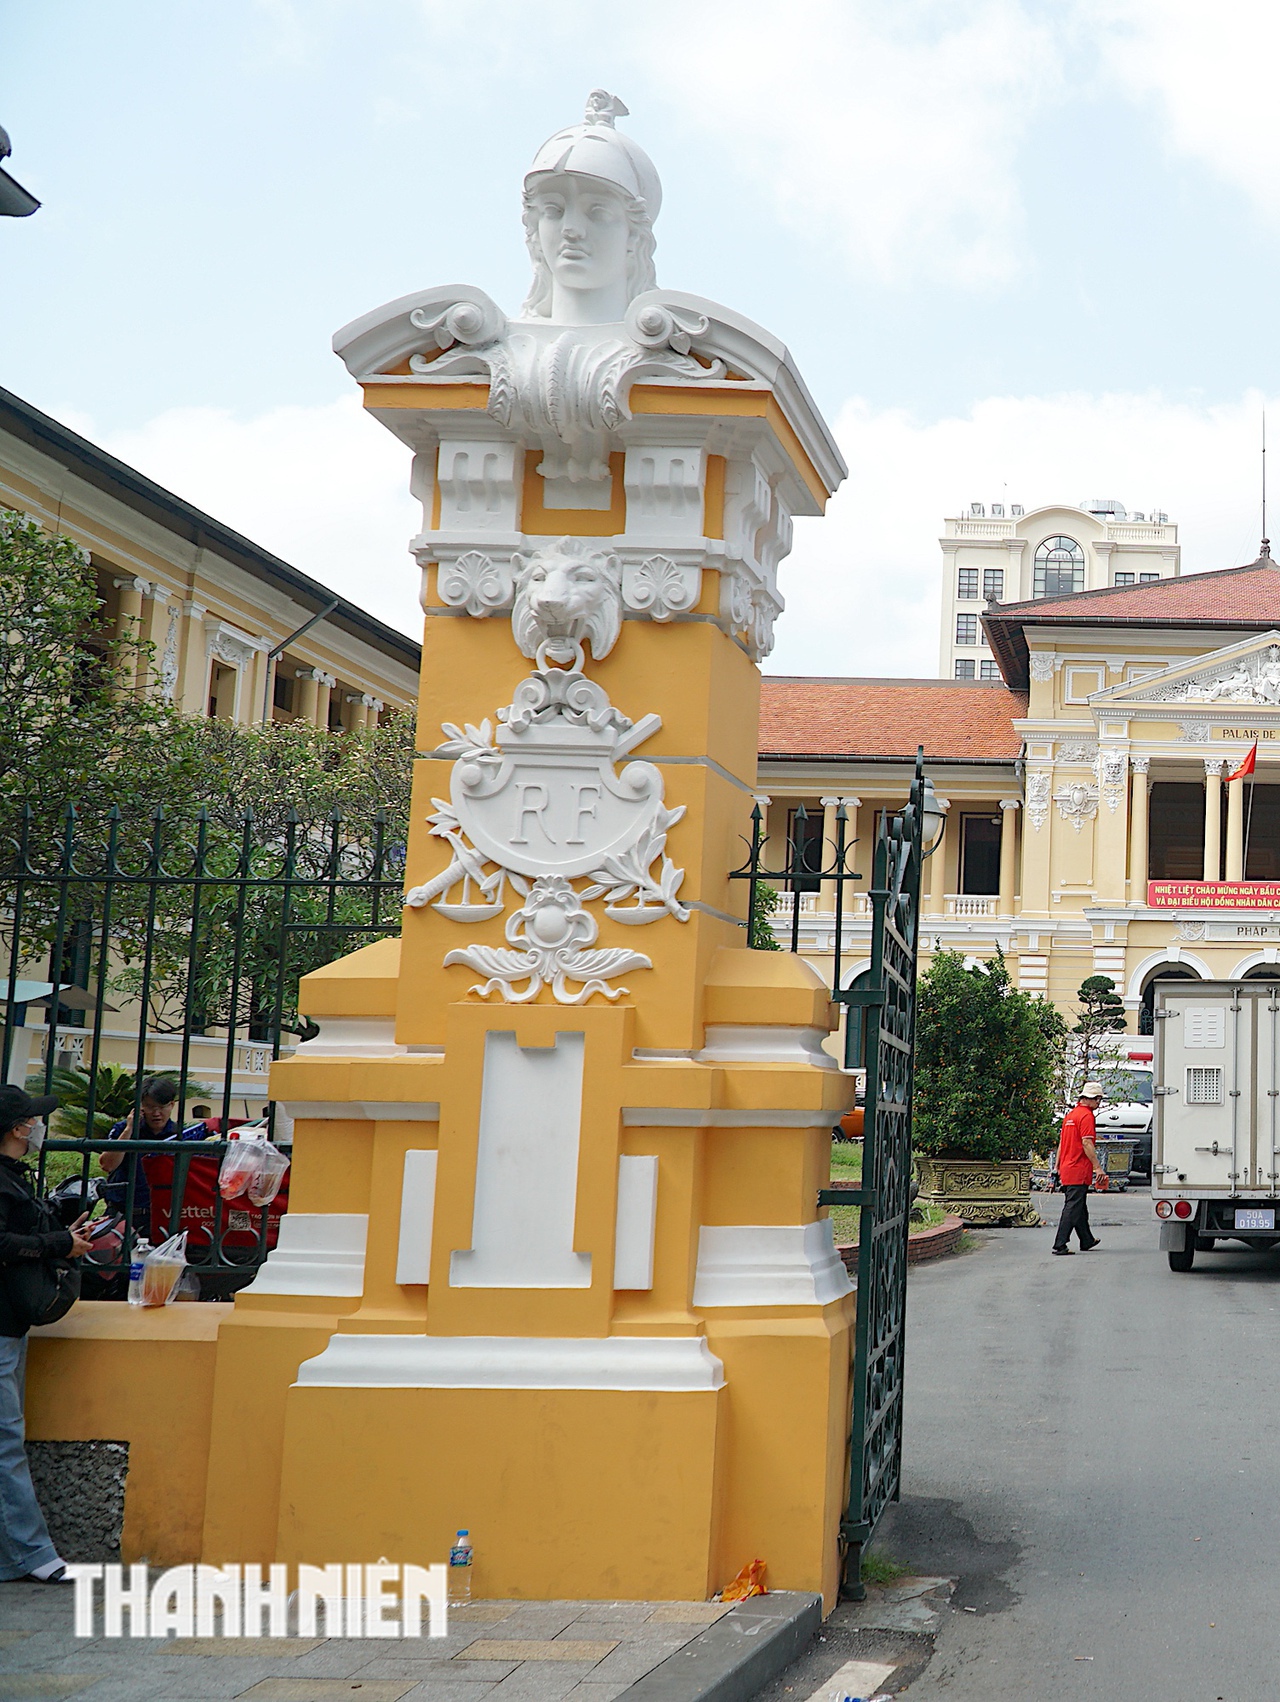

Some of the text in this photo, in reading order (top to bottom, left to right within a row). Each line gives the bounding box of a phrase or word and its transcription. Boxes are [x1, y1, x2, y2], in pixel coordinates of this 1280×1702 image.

[1222, 729, 1259, 739] PALAIS
[1262, 730, 1276, 739] DE
[1155, 884, 1177, 895] NHIỆT
[1178, 884, 1194, 896] LIỆT
[1196, 884, 1216, 895] CHÀO
[1217, 885, 1238, 895] MỪNG
[1239, 886, 1259, 896] NGÀY
[1156, 896, 1166, 905] VÀ
[1167, 897, 1180, 907] ĐẠI
[1181, 895, 1199, 906] BIỂU
[1200, 896, 1213, 907] HỘI
[1236, 896, 1256, 907] NHÂN
[1257, 897, 1272, 907] DÂN
[162, 1206, 216, 1218] vettel
[1246, 1211, 1263, 1219] 50A
[1239, 1219, 1270, 1228] 019.95
